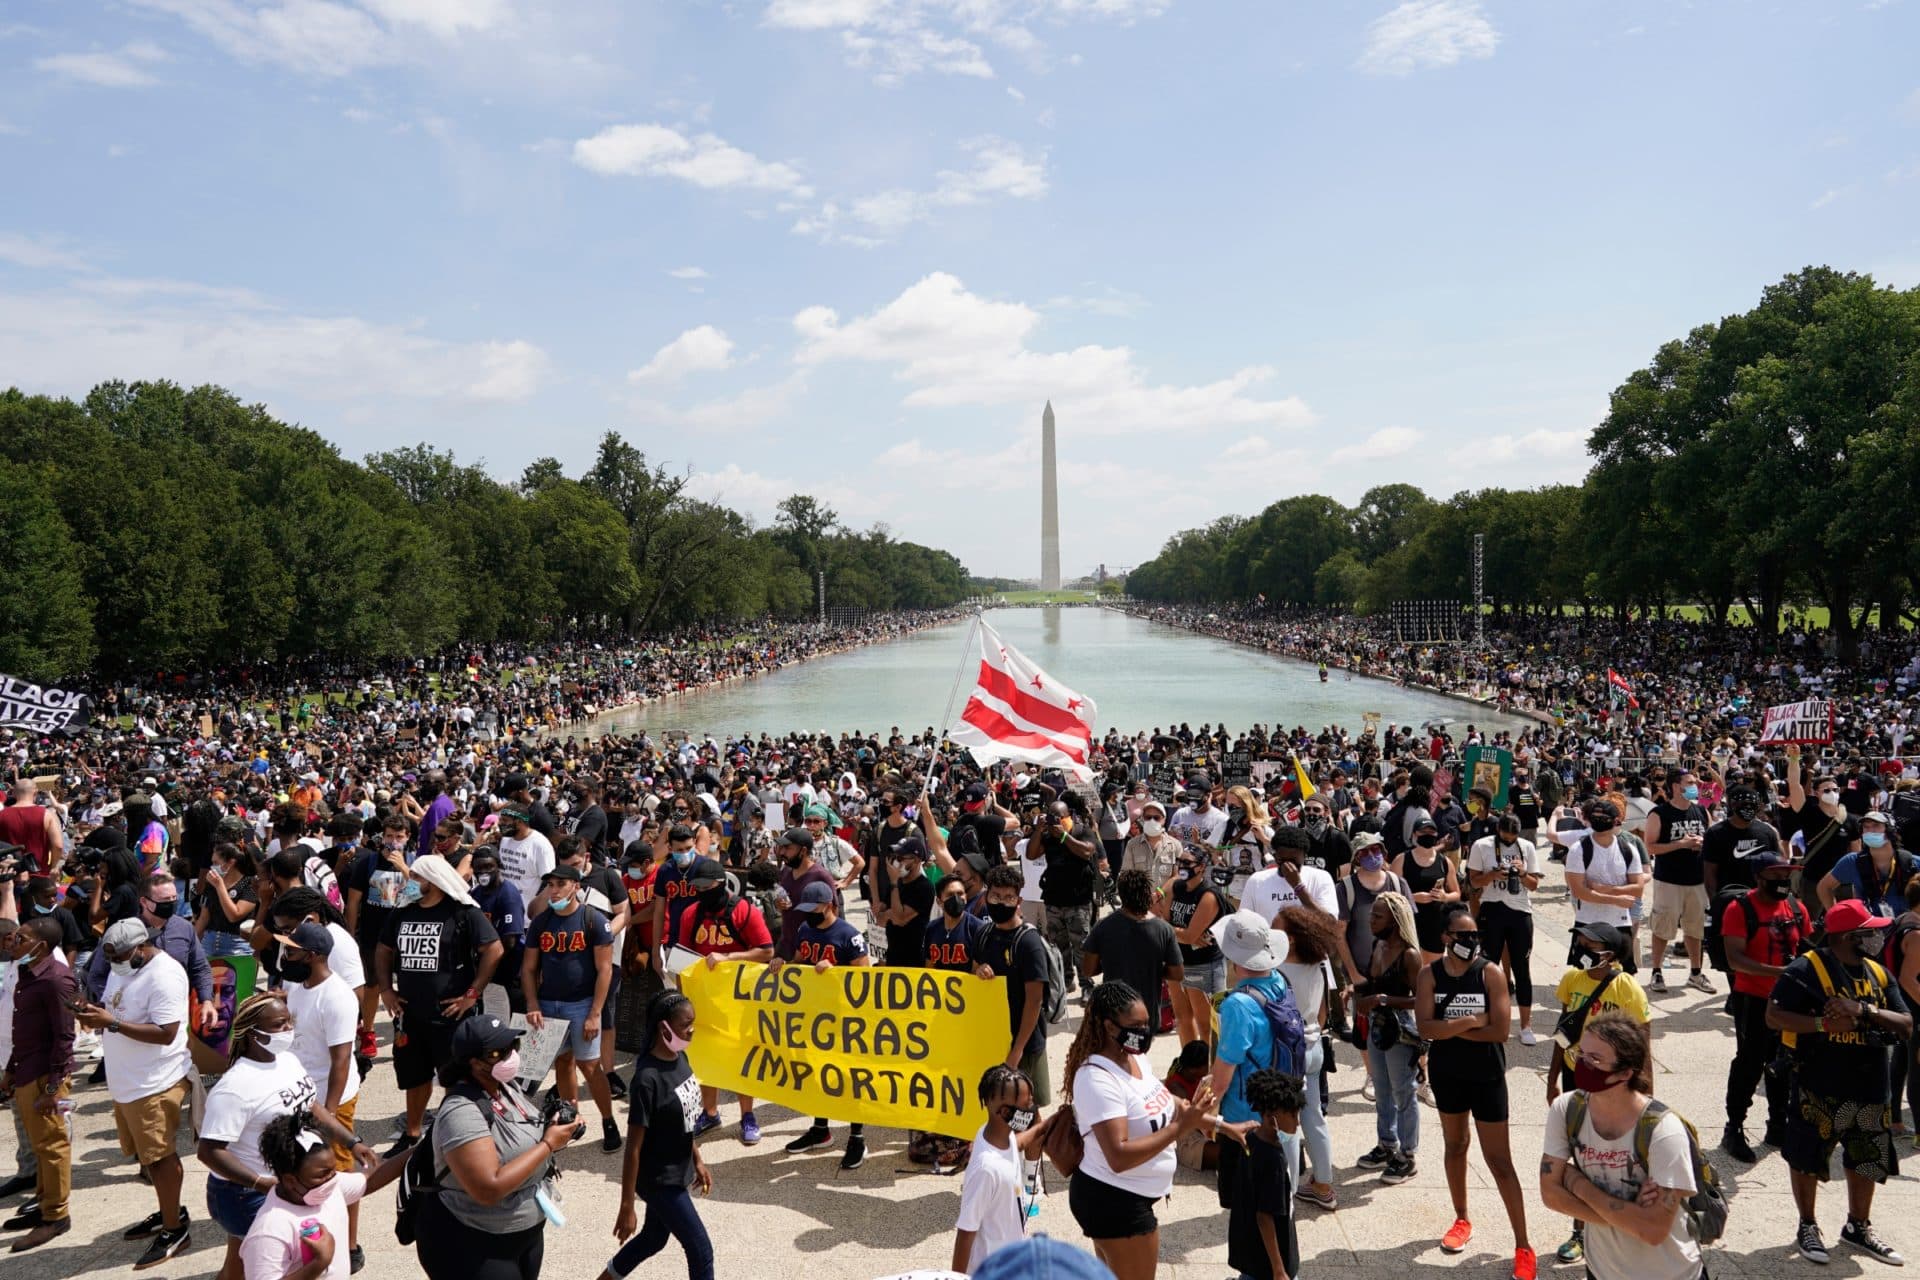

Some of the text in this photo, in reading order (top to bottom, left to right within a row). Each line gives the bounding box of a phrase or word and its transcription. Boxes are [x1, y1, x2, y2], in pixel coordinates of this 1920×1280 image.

[1768, 702, 1830, 723] BLACK LIVES
[1771, 719, 1830, 741] MATTER
[1738, 840, 1757, 849] NIKE
[401, 924, 440, 936] BLACK
[399, 937, 437, 956] LIVES
[733, 964, 966, 1014] LAS VIDAS
[758, 1010, 929, 1060] NEGRAS
[740, 1045, 966, 1117] IMPORTAN
